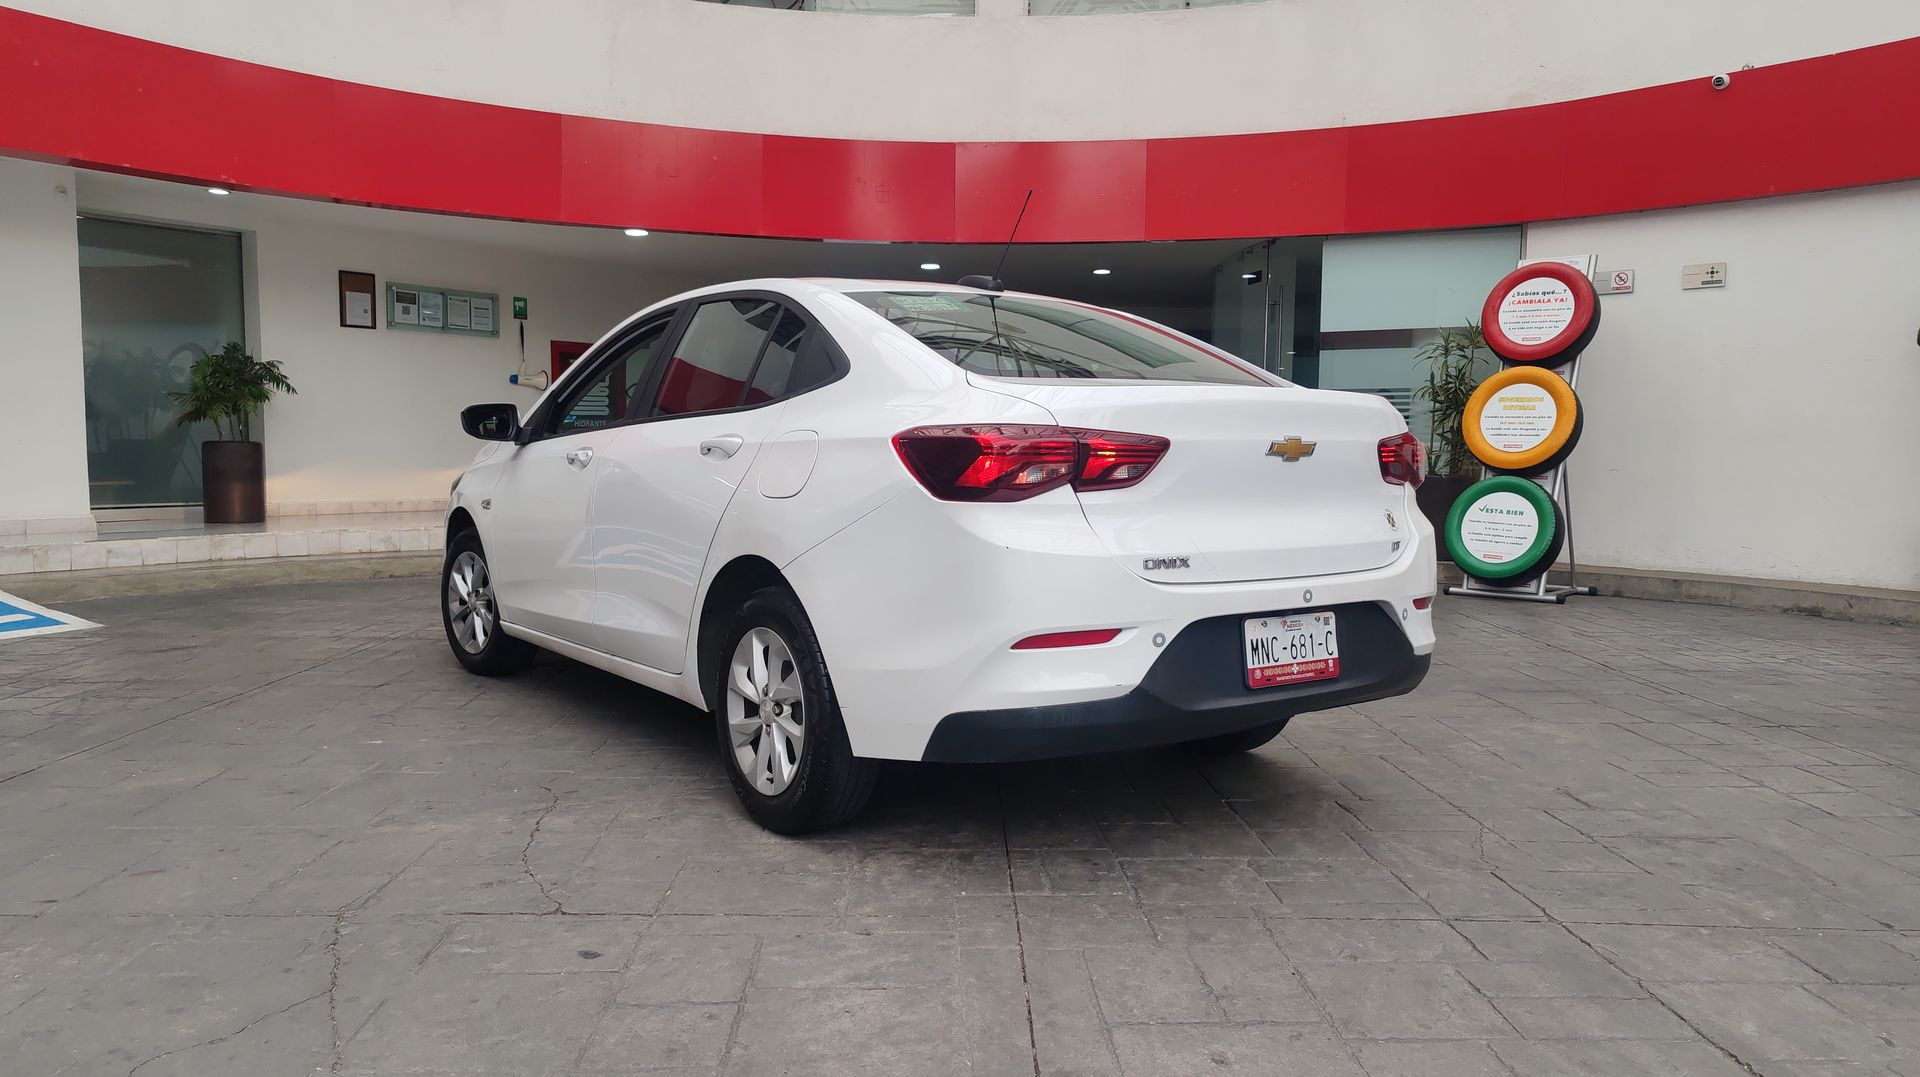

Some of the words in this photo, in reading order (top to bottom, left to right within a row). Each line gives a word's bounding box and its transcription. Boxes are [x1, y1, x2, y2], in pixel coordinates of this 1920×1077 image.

[1512, 290, 1540, 298] ¿Sabías
[1143, 556, 1190, 570] ONIX
[1250, 631, 1334, 665] MNC-681-C
